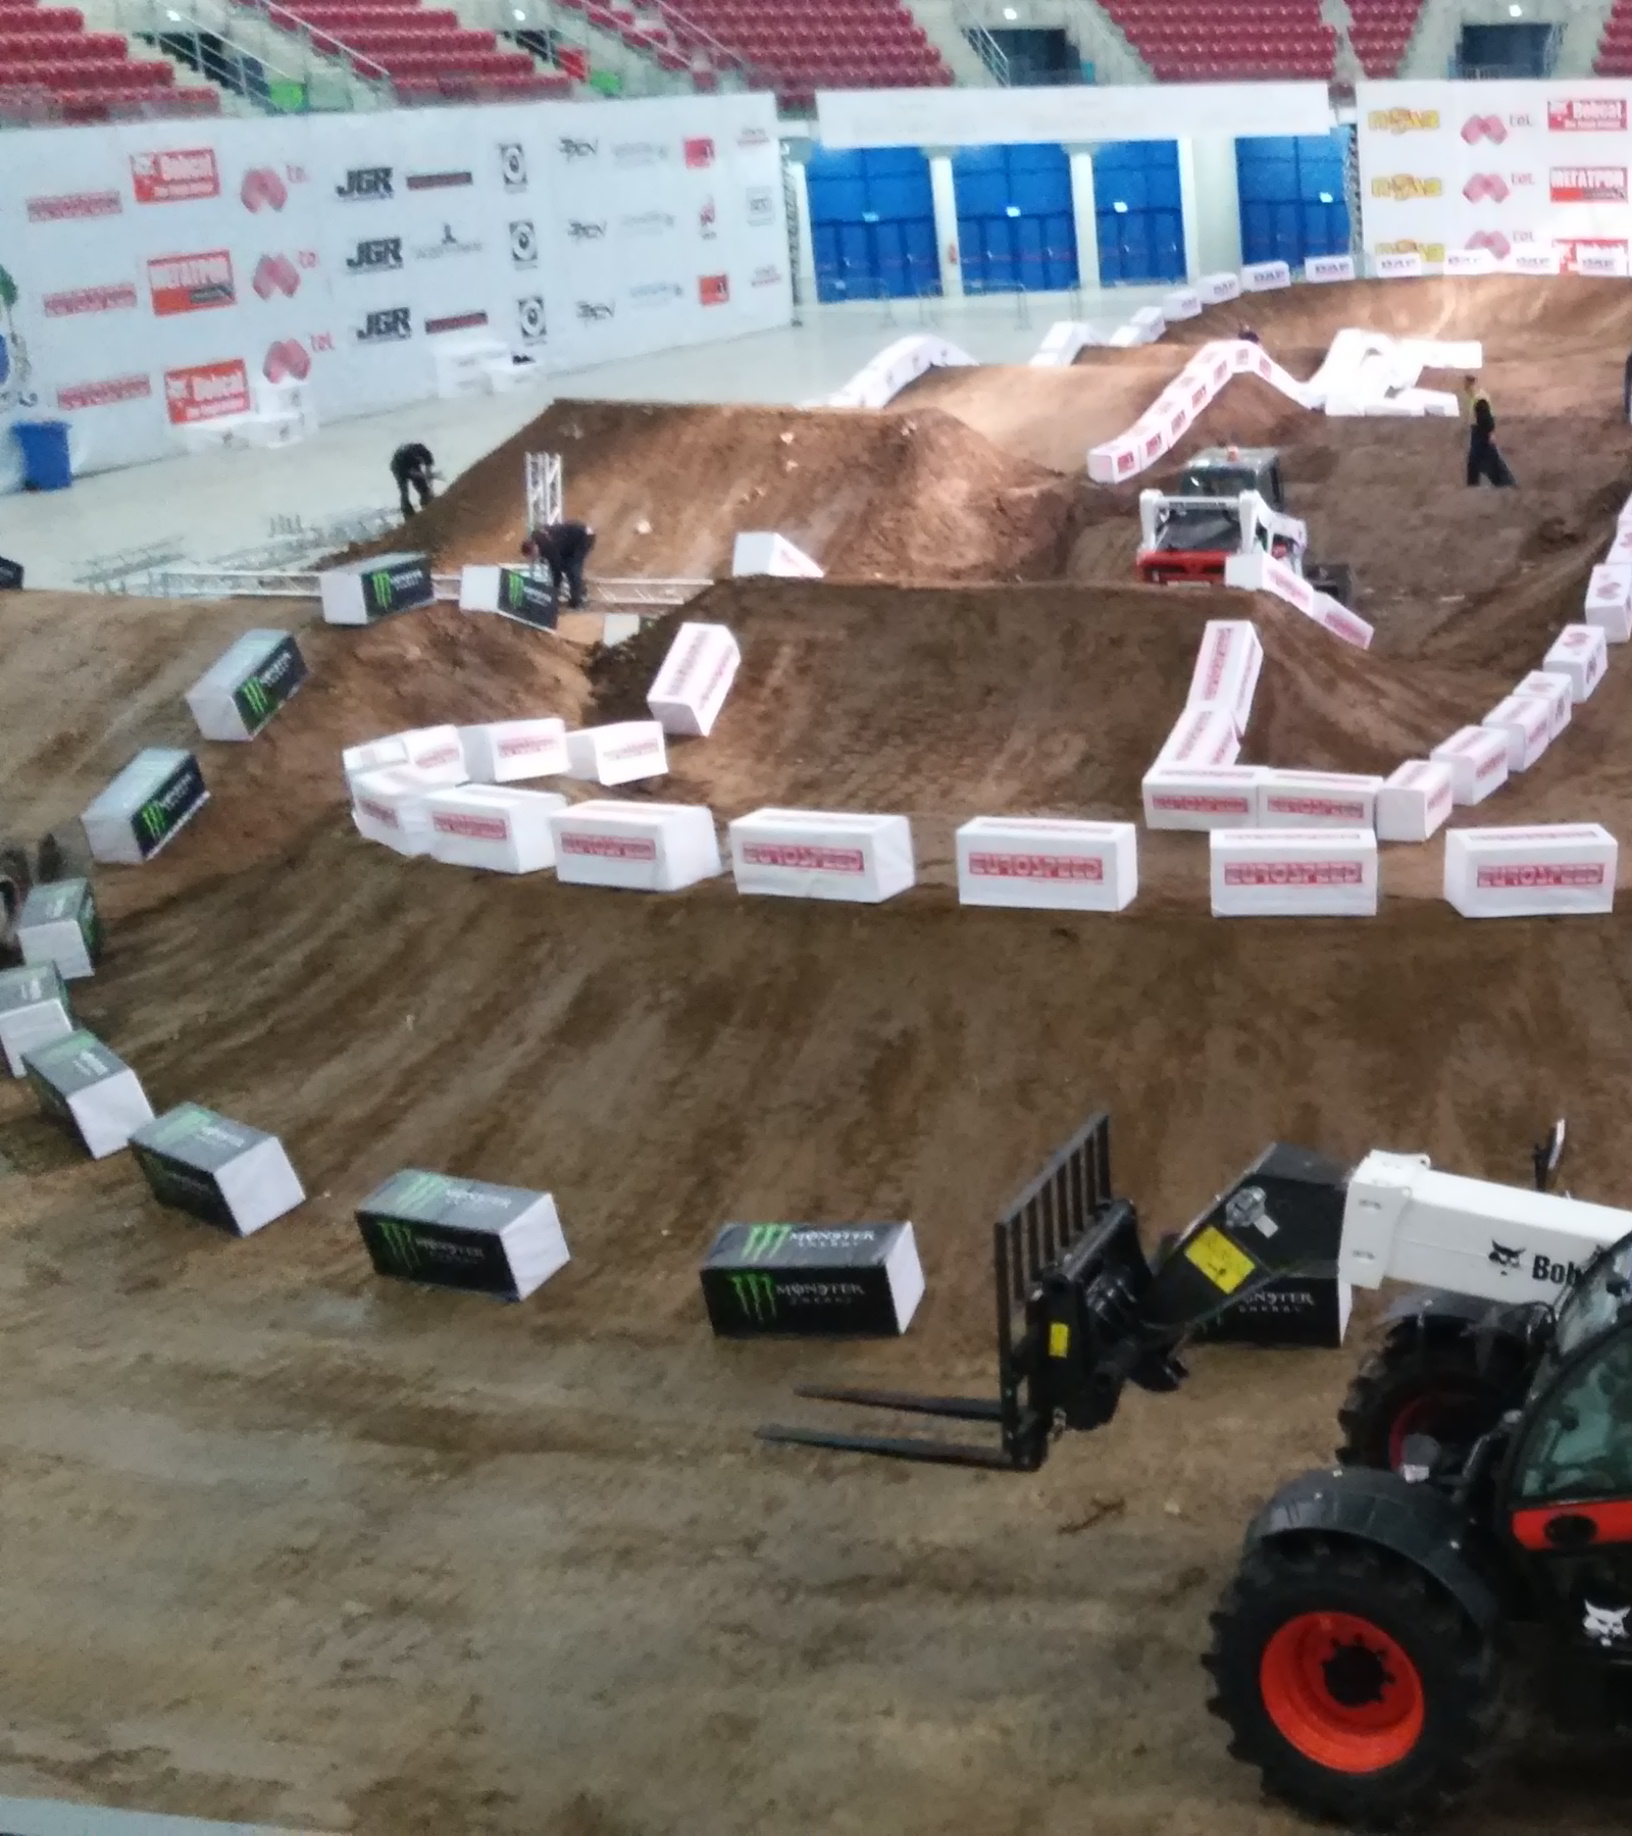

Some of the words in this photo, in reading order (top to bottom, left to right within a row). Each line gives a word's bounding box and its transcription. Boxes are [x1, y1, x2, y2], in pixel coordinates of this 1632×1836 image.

[788, 1229, 876, 1242] MONSTER
[1531, 1253, 1582, 1286] Bob
[775, 1283, 866, 1297] MONSTER
[1244, 1291, 1316, 1306] NSTER
